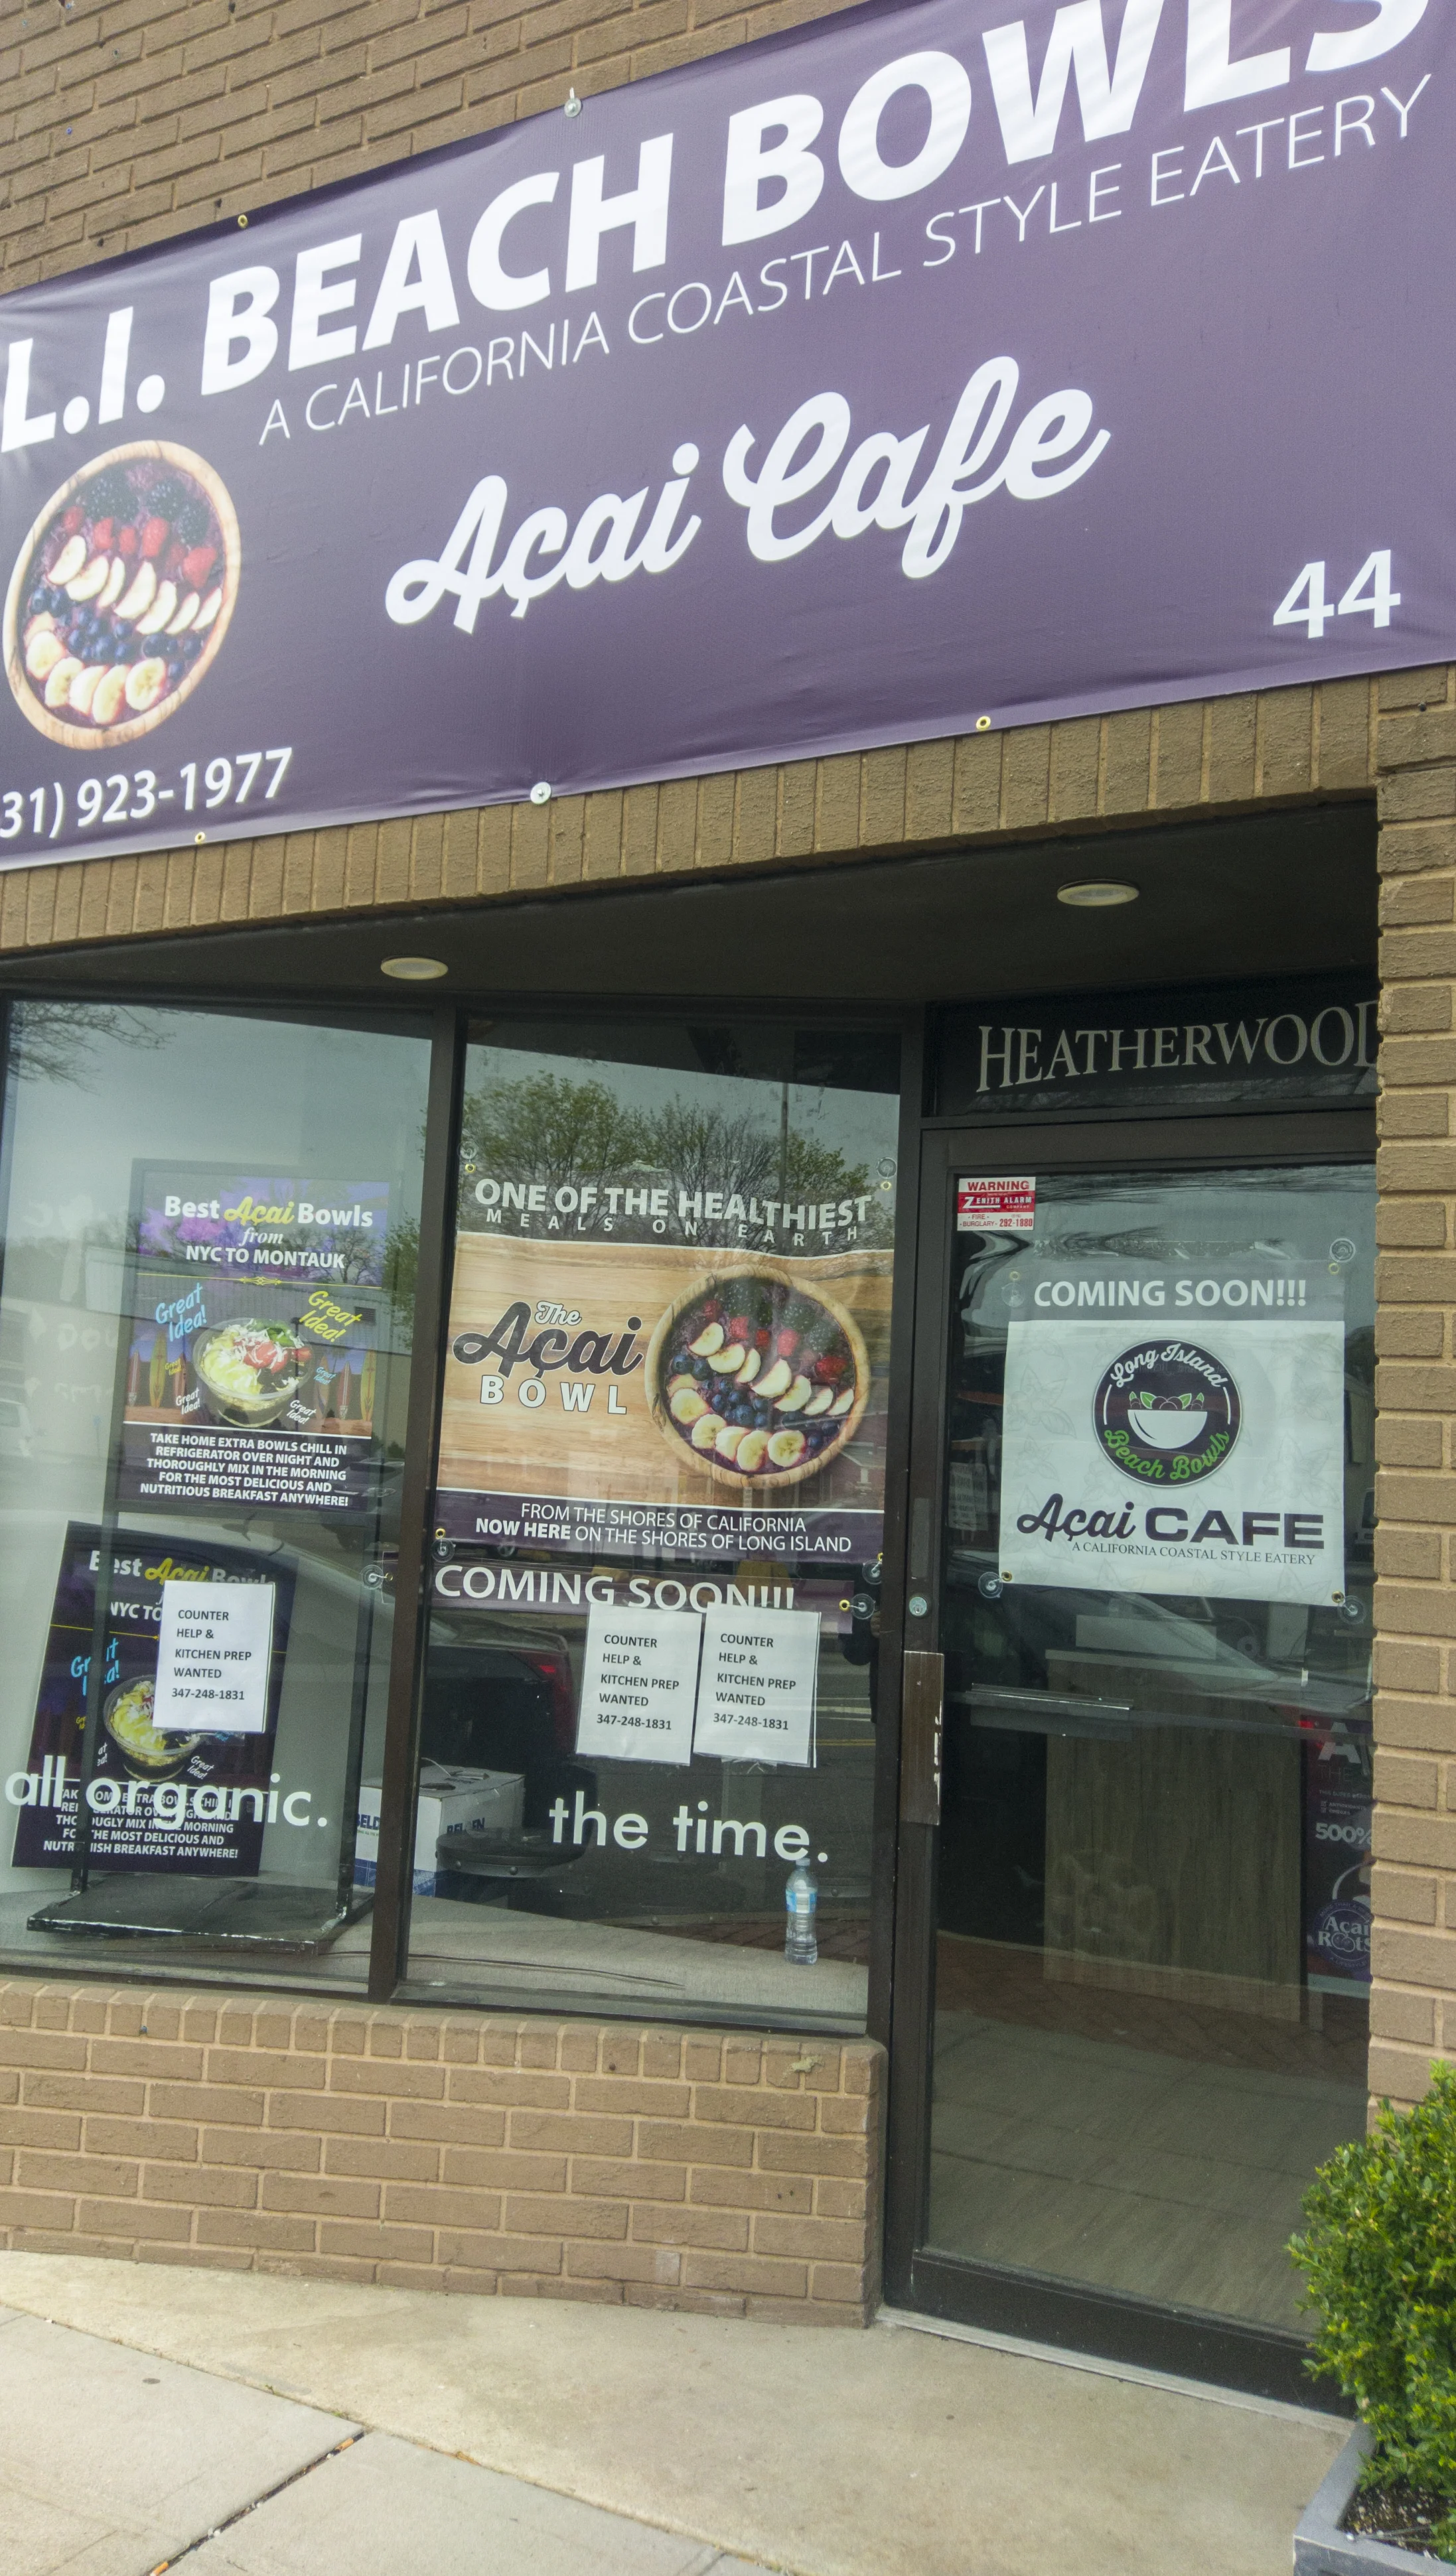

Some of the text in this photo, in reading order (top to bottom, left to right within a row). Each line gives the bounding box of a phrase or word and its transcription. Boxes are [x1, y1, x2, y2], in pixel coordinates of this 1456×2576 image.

[259, 74, 1432, 445] A CALIFORNIA COASTAL STYLE EATERY
[0, 306, 165, 452] L.I.
[201, 133, 674, 396] BEACH
[722, 356, 1112, 579] Cafe
[1273, 549, 1401, 639] 44
[77, 747, 293, 827] 923-1977
[967, 1180, 1030, 1191] WARNING
[164, 1195, 220, 1219] Best
[297, 1203, 374, 1227] Bowls
[474, 1178, 872, 1231] ONE OF THE HEALTHIEST
[238, 1227, 285, 1247] from
[486, 1208, 858, 1247] MEALS ON EARTH
[186, 1245, 346, 1269] NYC TO MONTAUK
[155, 1282, 203, 1325] Great
[1034, 1279, 1307, 1307] COMING SOON!!!
[309, 1290, 363, 1327] Great
[534, 1300, 582, 1327] The
[169, 1304, 208, 1342] Idea!
[299, 1310, 346, 1343] Idea!
[316, 1367, 336, 1379] Great
[1110, 1343, 1228, 1388] Long Island
[175, 1387, 200, 1406] Great
[479, 1374, 628, 1415] BOWL
[181, 1398, 200, 1415] Idea!
[286, 1409, 310, 1425] Idea!
[290, 1399, 317, 1416] Great
[150, 1432, 347, 1455] TAKE HOME EXTRA BOWLS CHILL IN
[155, 1446, 340, 1467] REFRIGERATOR OVER NIGHT AND
[1104, 1429, 1231, 1480] Beach Bowls
[147, 1458, 346, 1481] THOROUGHLY MIX IN THE MORNING
[159, 1471, 332, 1492] FOR THE MOST DELICIOUS AND
[140, 1483, 348, 1507] NUTRITIOUS BREAKFAST ANYWHERE!
[521, 1503, 806, 1532] FROM THE SHORES OF CALIFORNIA
[476, 1518, 852, 1552] NOW HERE ON THE SHORES OF LONG ISLAND
[1145, 1507, 1325, 1550] CAFE
[1072, 1541, 1316, 1566] A CALIFORNIA COASTAL STYLE EATERY
[435, 1564, 794, 1613] COMING SOON!!!
[178, 1609, 230, 1621] COUNTER
[177, 1628, 214, 1639] HELP &
[603, 1634, 658, 1649] COUNTER
[720, 1633, 774, 1648] COUNTER
[175, 1649, 252, 1661] KITCHEN PREP
[602, 1653, 642, 1666] HELP &
[719, 1652, 758, 1666] HELP &
[173, 1667, 222, 1678] WANTED
[601, 1674, 680, 1690] KITCHEN PREP
[717, 1673, 796, 1690] KITCHEN PREP
[171, 1688, 245, 1700] 347-248-1831
[599, 1692, 649, 1707] WANTED
[715, 1692, 766, 1706] WANTED
[597, 1714, 672, 1730] 347-248-1831
[713, 1713, 789, 1730] 347-248-1831
[187, 1765, 208, 1780] Idea!
[190, 1755, 214, 1771] Great
[5, 1755, 328, 1830] all organic.
[125, 1818, 147, 1829] MIX
[184, 1822, 234, 1833] MORNING
[549, 1790, 829, 1863] the time.
[110, 1830, 142, 1842] MOST
[144, 1832, 199, 1844] DELICIOUS
[201, 1835, 224, 1846] AND
[113, 1843, 176, 1856] BREAKFAST
[177, 1846, 239, 1859] ANYWHERE!
